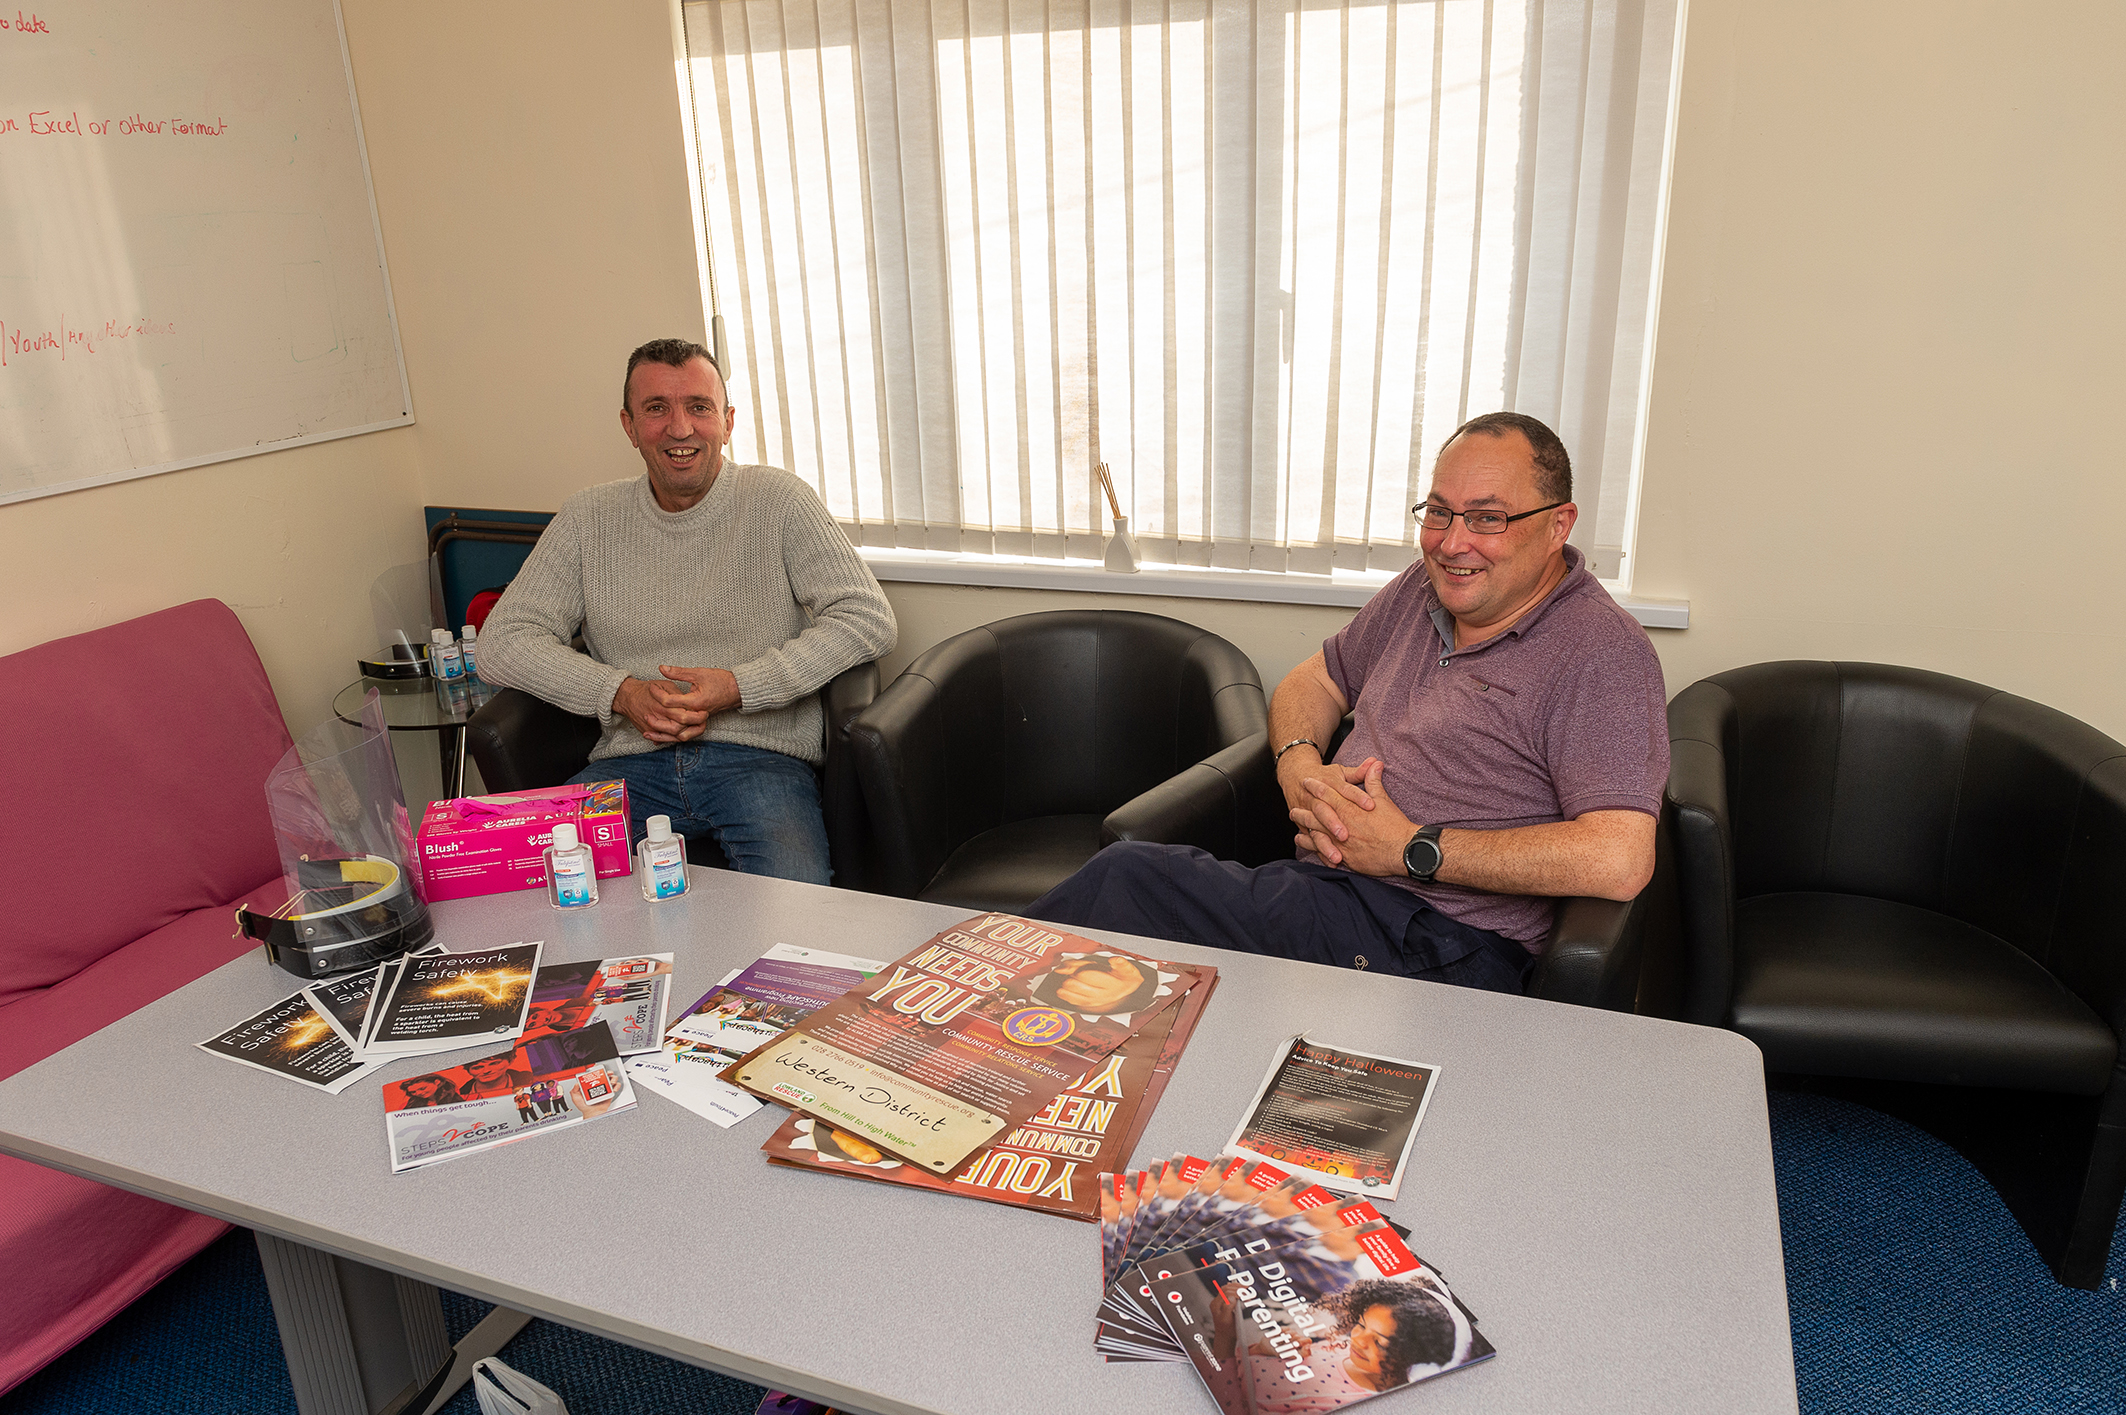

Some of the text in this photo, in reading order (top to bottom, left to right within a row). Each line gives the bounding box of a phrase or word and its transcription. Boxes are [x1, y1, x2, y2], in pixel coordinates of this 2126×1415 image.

[16, 10, 50, 34] date
[29, 110, 82, 136] Excel
[89, 119, 110, 135] or
[495, 820, 526, 828] CARES
[496, 816, 537, 824] AURELIA
[598, 827, 610, 840] S
[425, 842, 459, 855] Blush
[970, 915, 1064, 957] YOUR
[417, 953, 509, 970] Firework
[942, 932, 1038, 970] COMMUNITY
[412, 968, 477, 981] Safety
[907, 945, 1016, 992] NEEDS
[328, 975, 378, 995] Fire
[336, 986, 374, 1004] Saf
[744, 986, 786, 997] Programme
[866, 966, 983, 1025] YOU
[400, 1001, 434, 1009] Fireworks
[636, 1004, 648, 1024] COPE
[220, 999, 308, 1046] Firework
[399, 1019, 429, 1027] sparkler
[437, 1015, 471, 1024] equivalent
[240, 1016, 304, 1051] Safety
[691, 1030, 714, 1039] Peace
[942, 1028, 996, 1052] COMMUNITY
[995, 1048, 1032, 1067] RESCUE
[1031, 1062, 1071, 1082] SERVICE
[951, 1040, 1045, 1080] COMMUNITY RELATIONS SERVICE
[967, 1029, 1058, 1068] COMMUNITY RESPONSE SERVICE
[645, 1064, 669, 1073] Peace
[1292, 1054, 1313, 1063] Advice
[1322, 1061, 1340, 1071] Keep
[1340, 1065, 1352, 1073] You
[1352, 1068, 1368, 1077] Safe
[1295, 1043, 1423, 1081] Happy Halloween
[773, 1086, 802, 1099] RESCUE
[775, 1052, 948, 1132] Western District
[777, 1082, 806, 1096] LOWLAND
[811, 1045, 976, 1118] 028 2766 0519 info@communityrescue.org
[394, 1109, 419, 1118] When
[420, 1106, 448, 1115] things
[1274, 1089, 1314, 1104] Information
[1325, 1101, 1352, 1113] Parents
[819, 1102, 841, 1115] From
[843, 1110, 856, 1122] Hill
[855, 1117, 864, 1126] to
[863, 1122, 884, 1135] High
[1028, 1094, 1119, 1134] NEE
[401, 1138, 447, 1154] STEPS
[463, 1122, 509, 1139] COPE
[412, 1150, 435, 1160] young
[436, 1144, 460, 1154] people
[460, 1138, 488, 1147] affected
[488, 1134, 498, 1142] by
[498, 1128, 514, 1138] their
[514, 1122, 539, 1133] parents
[539, 1114, 567, 1125] drinking
[1002, 1128, 1102, 1158] COMMUN
[1251, 1178, 1266, 1189] better
[1302, 1196, 1312, 1205] your
[1349, 1211, 1359, 1221] your
[1362, 1238, 1391, 1272] better digital life
[1368, 1236, 1379, 1247] your
[1376, 1244, 1390, 1261] family
[1378, 1239, 1390, 1253] guide
[1390, 1254, 1401, 1264] help
[1258, 1261, 1326, 1338] Digital
[1227, 1270, 1315, 1384] Parenting
